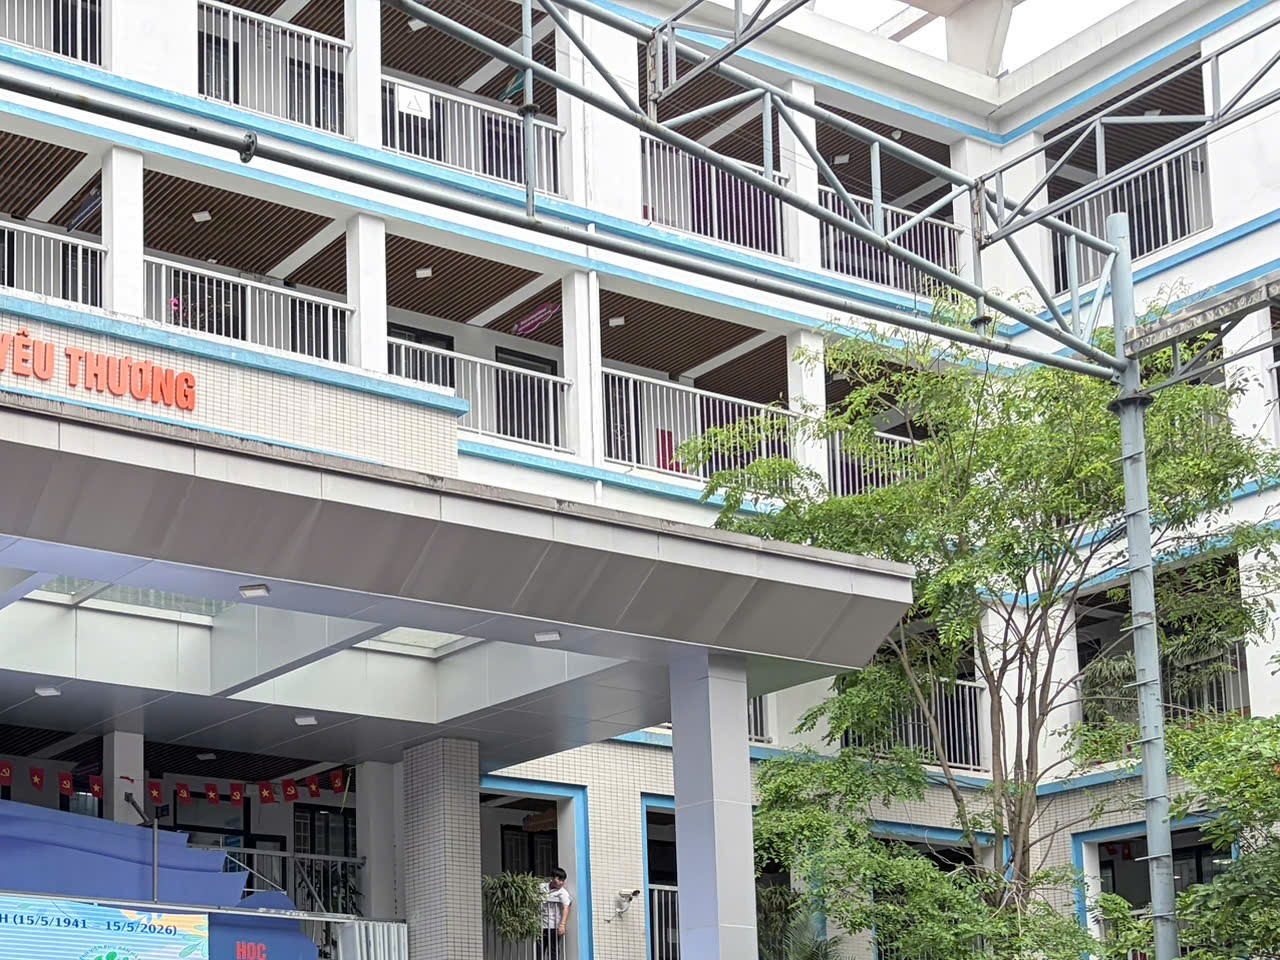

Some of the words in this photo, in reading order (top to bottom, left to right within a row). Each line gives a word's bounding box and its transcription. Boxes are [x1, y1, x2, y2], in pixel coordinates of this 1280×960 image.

[65, 345, 197, 411] THƯƠNG
[13, 913, 88, 929] (15/5/1941
[105, 920, 178, 936] 15/5/2026)
